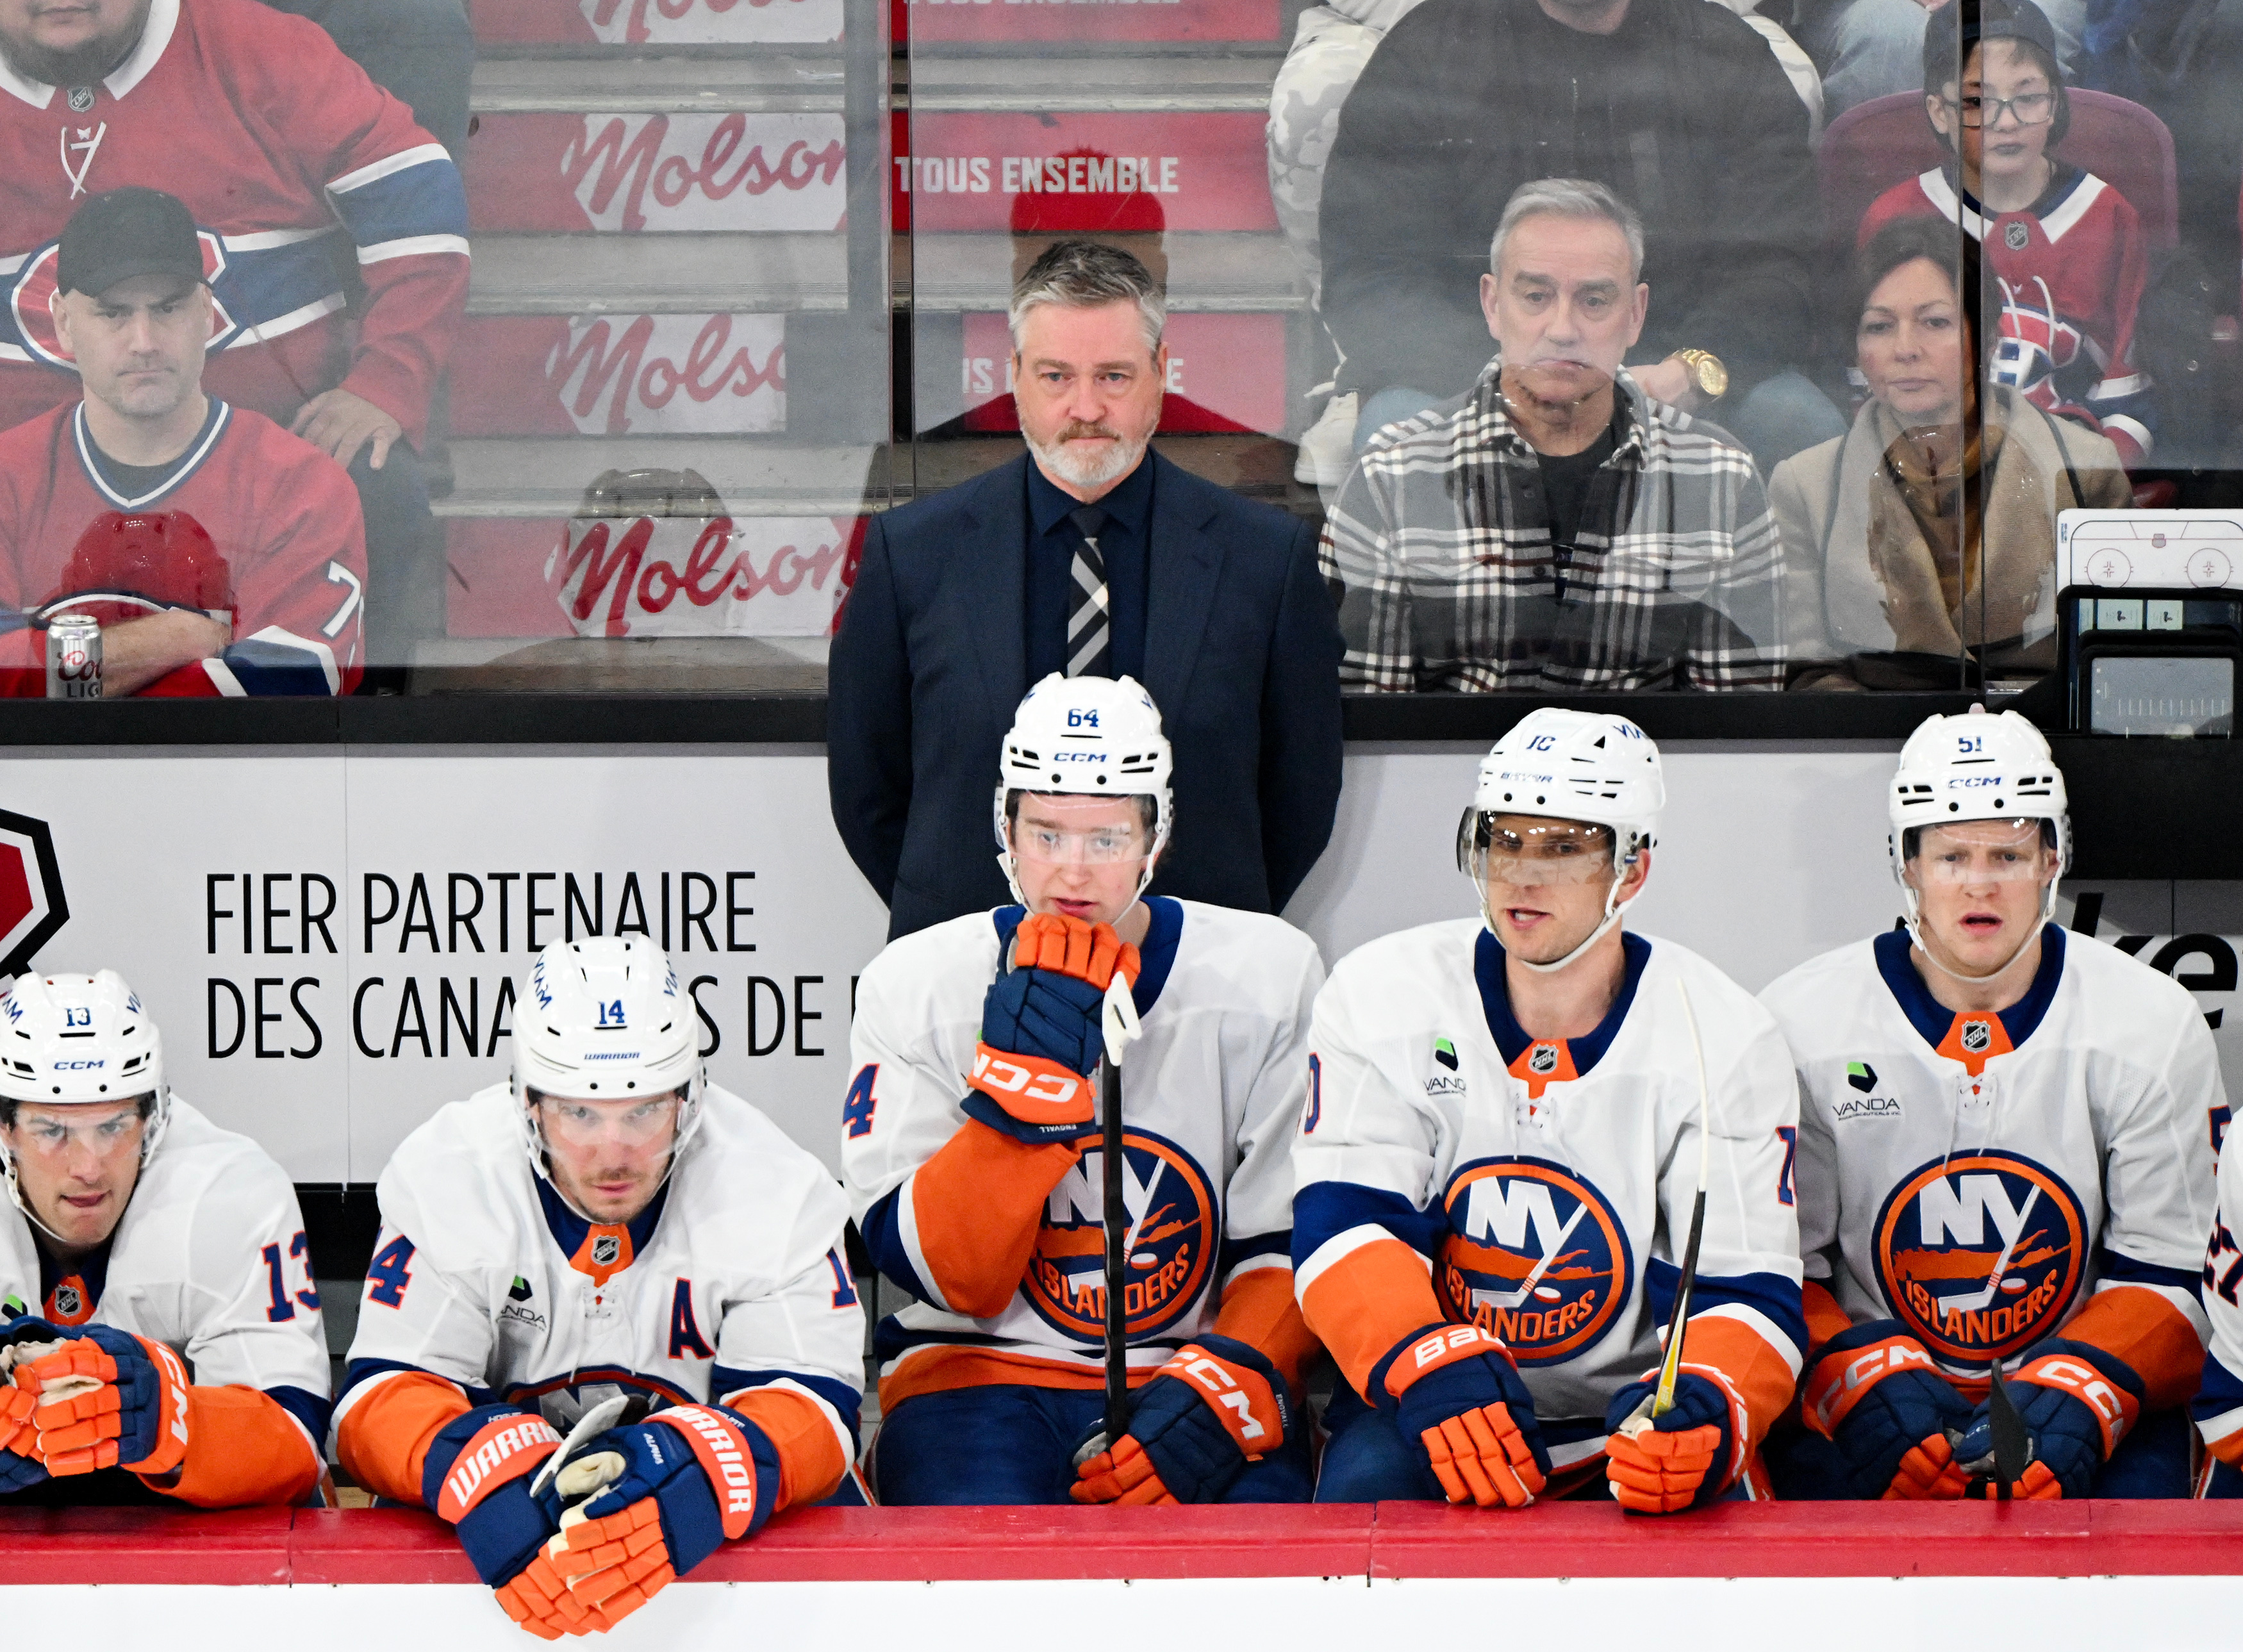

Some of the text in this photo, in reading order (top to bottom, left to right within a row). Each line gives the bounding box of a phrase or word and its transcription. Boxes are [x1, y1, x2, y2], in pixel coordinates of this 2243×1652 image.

[895, 156, 1179, 193] TOUS ENSEMBLE
[1067, 708, 1100, 728] 64
[1054, 752, 1108, 763] CCM
[1958, 736, 1983, 753] 51
[1948, 776, 2002, 789] CCM
[206, 871, 756, 954] FIER PARTENAIRE
[65, 1007, 92, 1027] 13
[207, 976, 323, 1059] DES
[747, 975, 825, 1057] DE
[598, 999, 625, 1024] 14
[1967, 1027, 1986, 1046] NHL
[54, 1059, 105, 1070] CCM
[1832, 1098, 1900, 1116] VANDA
[1466, 1175, 1589, 1256] NY
[1919, 1174, 2042, 1246] NY
[261, 1230, 322, 1323] 13
[668, 1276, 716, 1360] A
[1446, 1261, 1596, 1342] ISLANDERS
[1905, 1268, 2058, 1344] ISLANDERS
[1816, 1345, 1934, 1428] CCM
